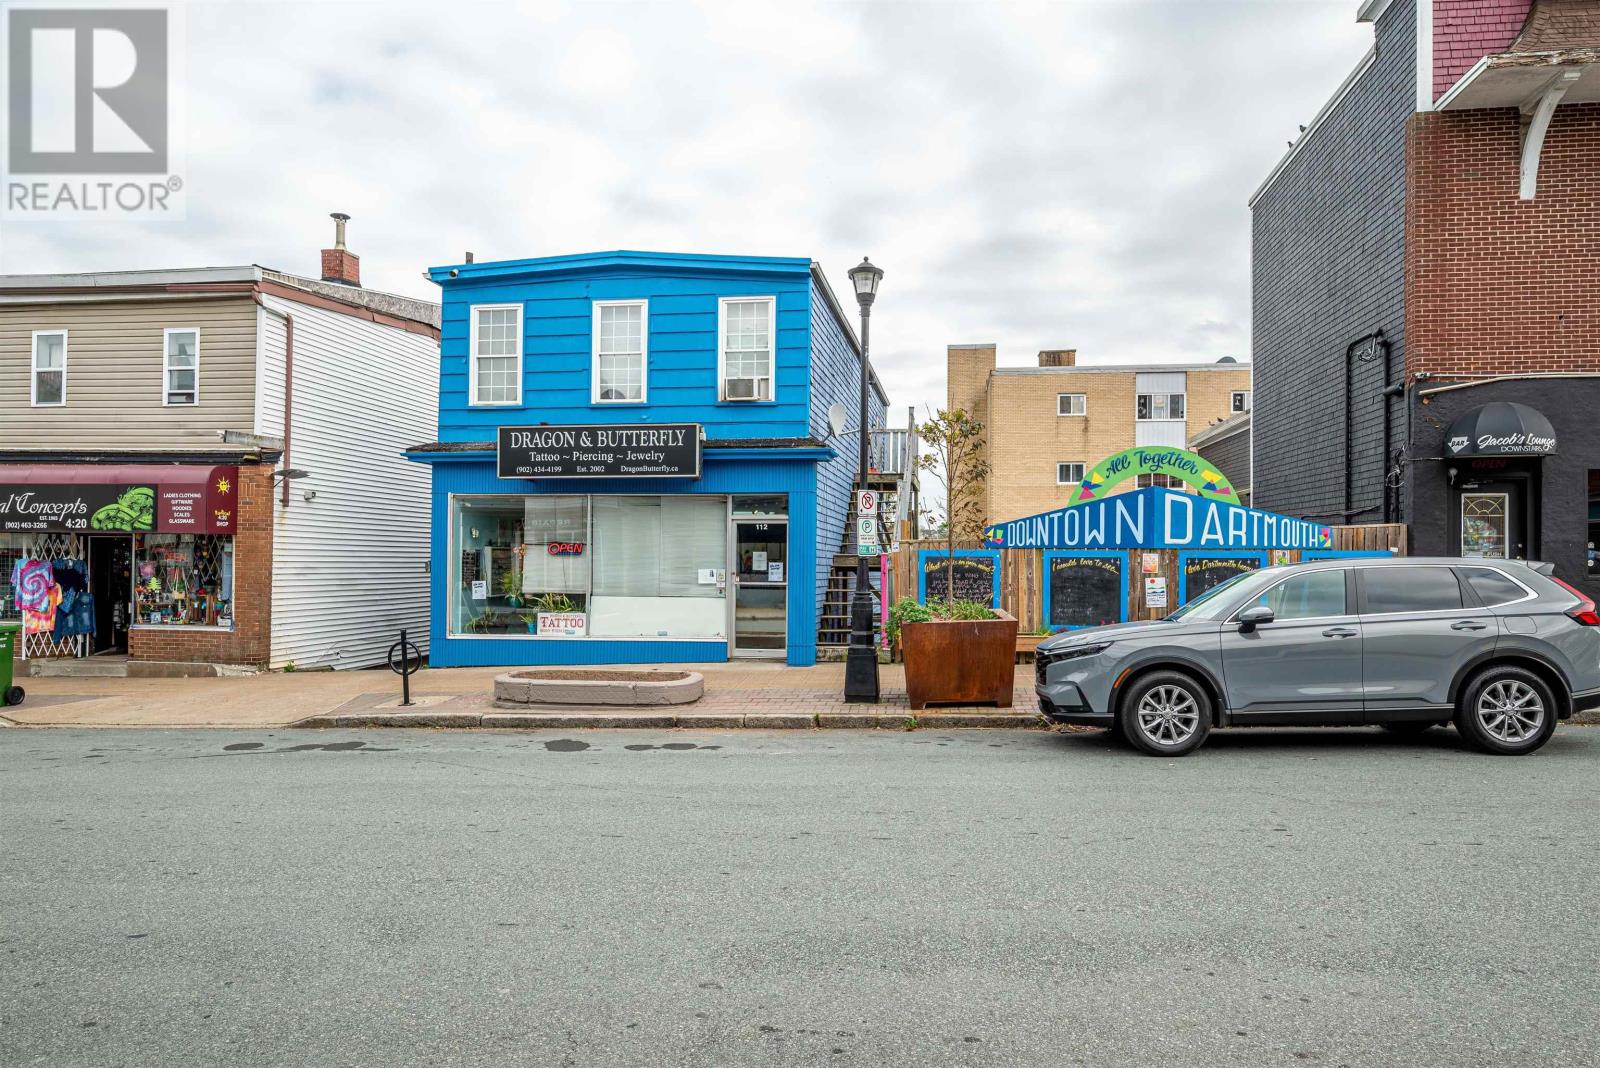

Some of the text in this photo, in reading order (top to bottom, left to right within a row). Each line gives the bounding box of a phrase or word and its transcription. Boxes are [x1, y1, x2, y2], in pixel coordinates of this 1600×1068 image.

[510, 429, 686, 448] DRAGON & BUTTERFLY
[1477, 433, 1556, 451] Jacob's Lounge
[528, 451, 560, 461] Tattoo
[573, 451, 614, 463] Piercing
[626, 450, 665, 462] Jewelry
[516, 466, 533, 474] (902)
[620, 465, 679, 474] DragonButterfly.ca
[1106, 450, 1198, 479] All Together
[15, 492, 88, 521] Concepts
[5, 521, 48, 529] (902) 463-3266
[65, 518, 87, 529] 4:20
[1007, 492, 1319, 547] DOWNTOWN DARTMOUTH
[548, 543, 583, 555] OPEN
[540, 616, 584, 628] TATTOO
